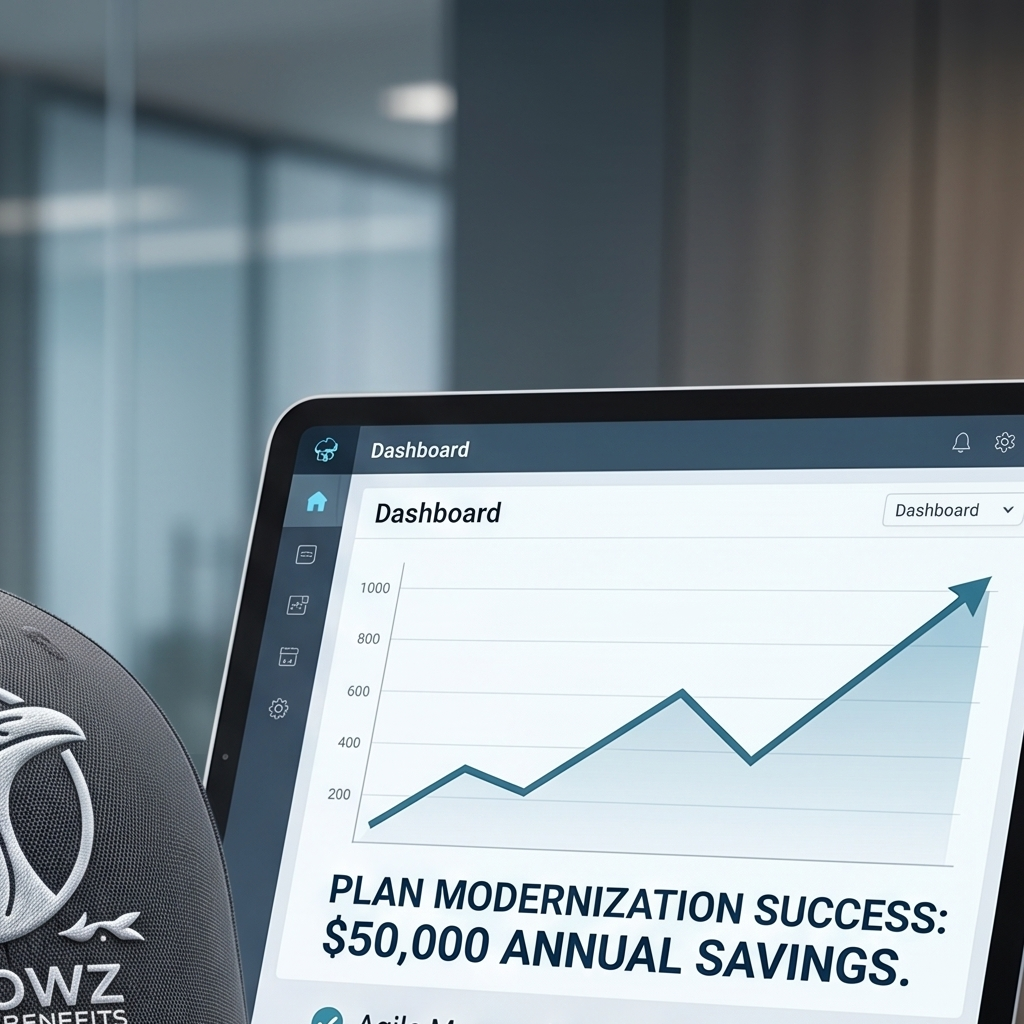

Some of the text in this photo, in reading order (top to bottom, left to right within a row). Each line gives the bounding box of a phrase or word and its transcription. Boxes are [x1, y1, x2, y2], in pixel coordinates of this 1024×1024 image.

[371, 440, 470, 459] Dashboard
[375, 501, 502, 524] Dashboard
[895, 502, 980, 517] Dashboard
[361, 581, 391, 594] 1000
[357, 632, 381, 645] 800
[347, 685, 370, 697] 600
[337, 736, 361, 749] 400
[327, 787, 351, 801] 200
[329, 874, 948, 935] PLAN MODERNIZATION SUCCESS:
[322, 914, 909, 987] $50,000 ANNUAL SAVINGS.
